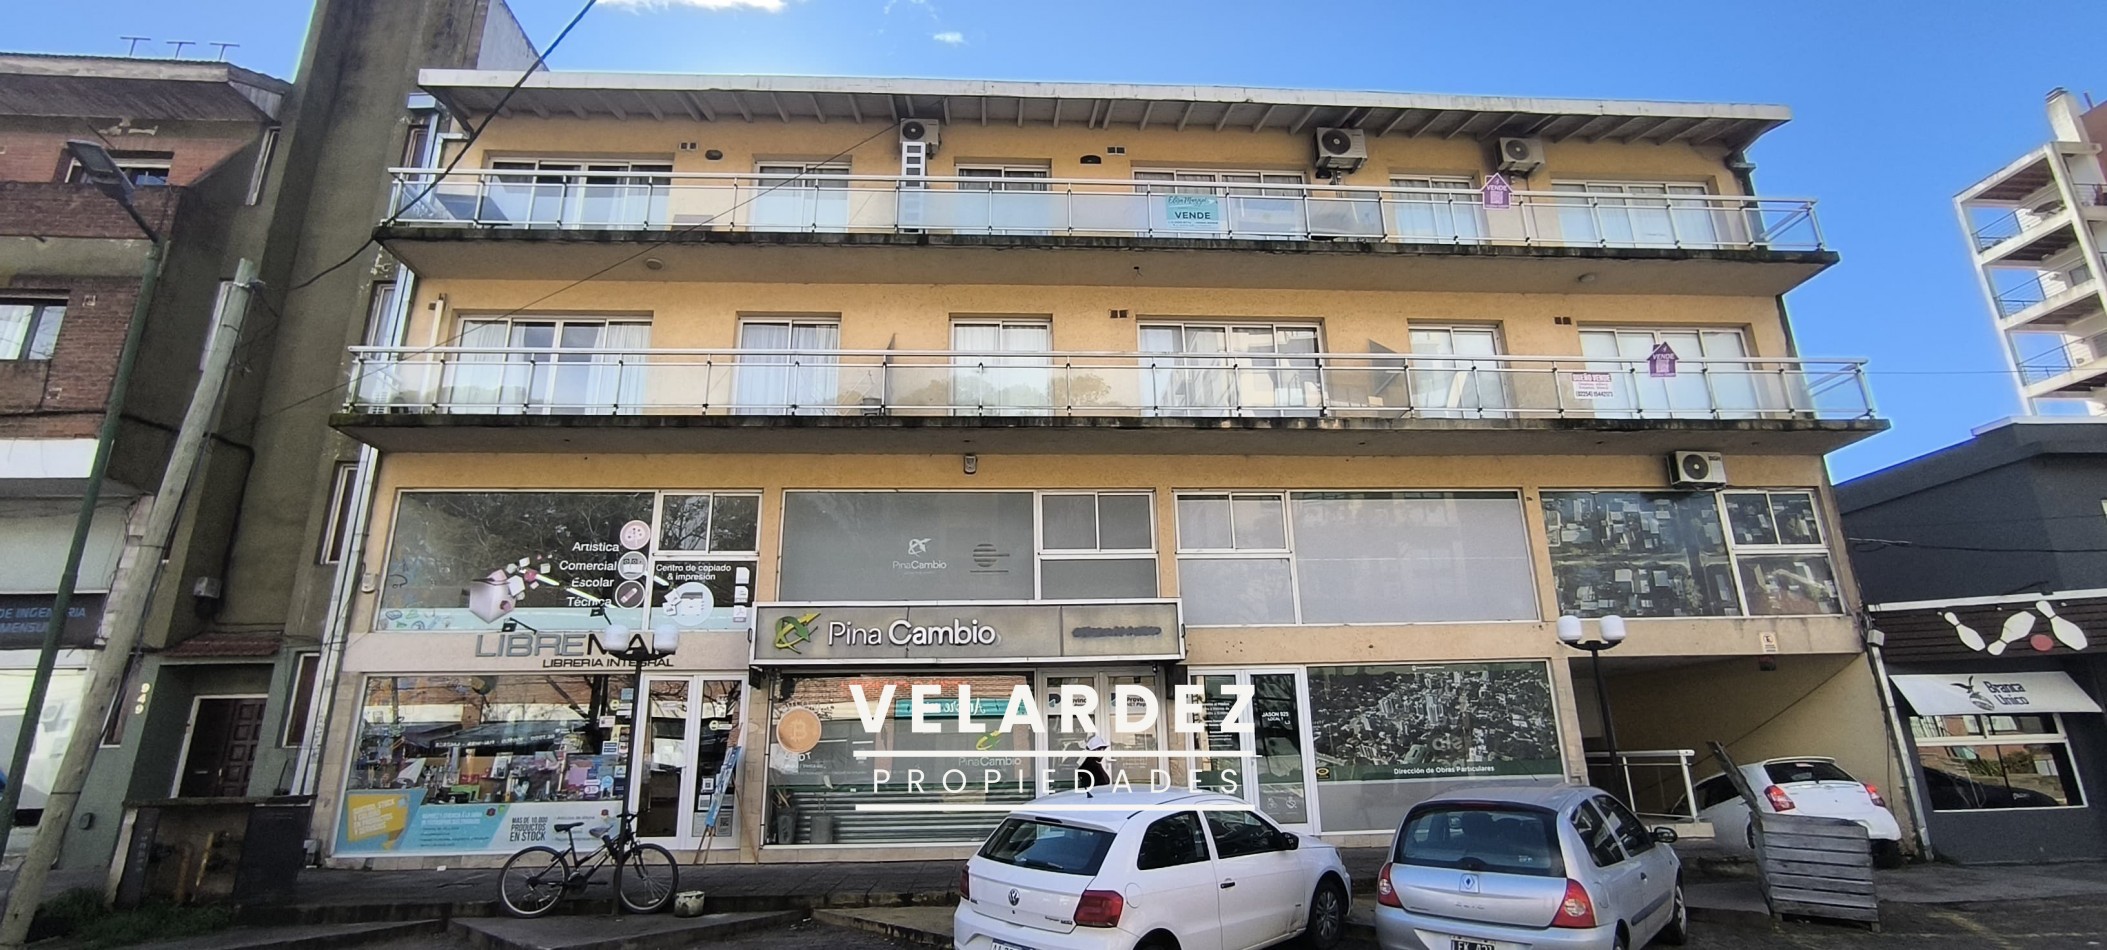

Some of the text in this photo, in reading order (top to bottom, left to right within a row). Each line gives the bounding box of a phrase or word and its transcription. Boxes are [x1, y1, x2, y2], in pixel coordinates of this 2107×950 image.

[1174, 211, 1211, 219] VENDE
[560, 561, 617, 571] Comercial
[656, 564, 731, 573] Centro de copiado
[571, 577, 615, 587] Escolar
[828, 618, 996, 646] Pina Cambio
[542, 658, 674, 668] LIBRERIA INTEGRAL
[1983, 680, 2026, 693] Branca
[134, 683, 150, 715] 949
[958, 756, 1022, 766] PinaCambio
[511, 823, 547, 831] PRODUCTOS
[510, 831, 547, 841] EN STOCK
